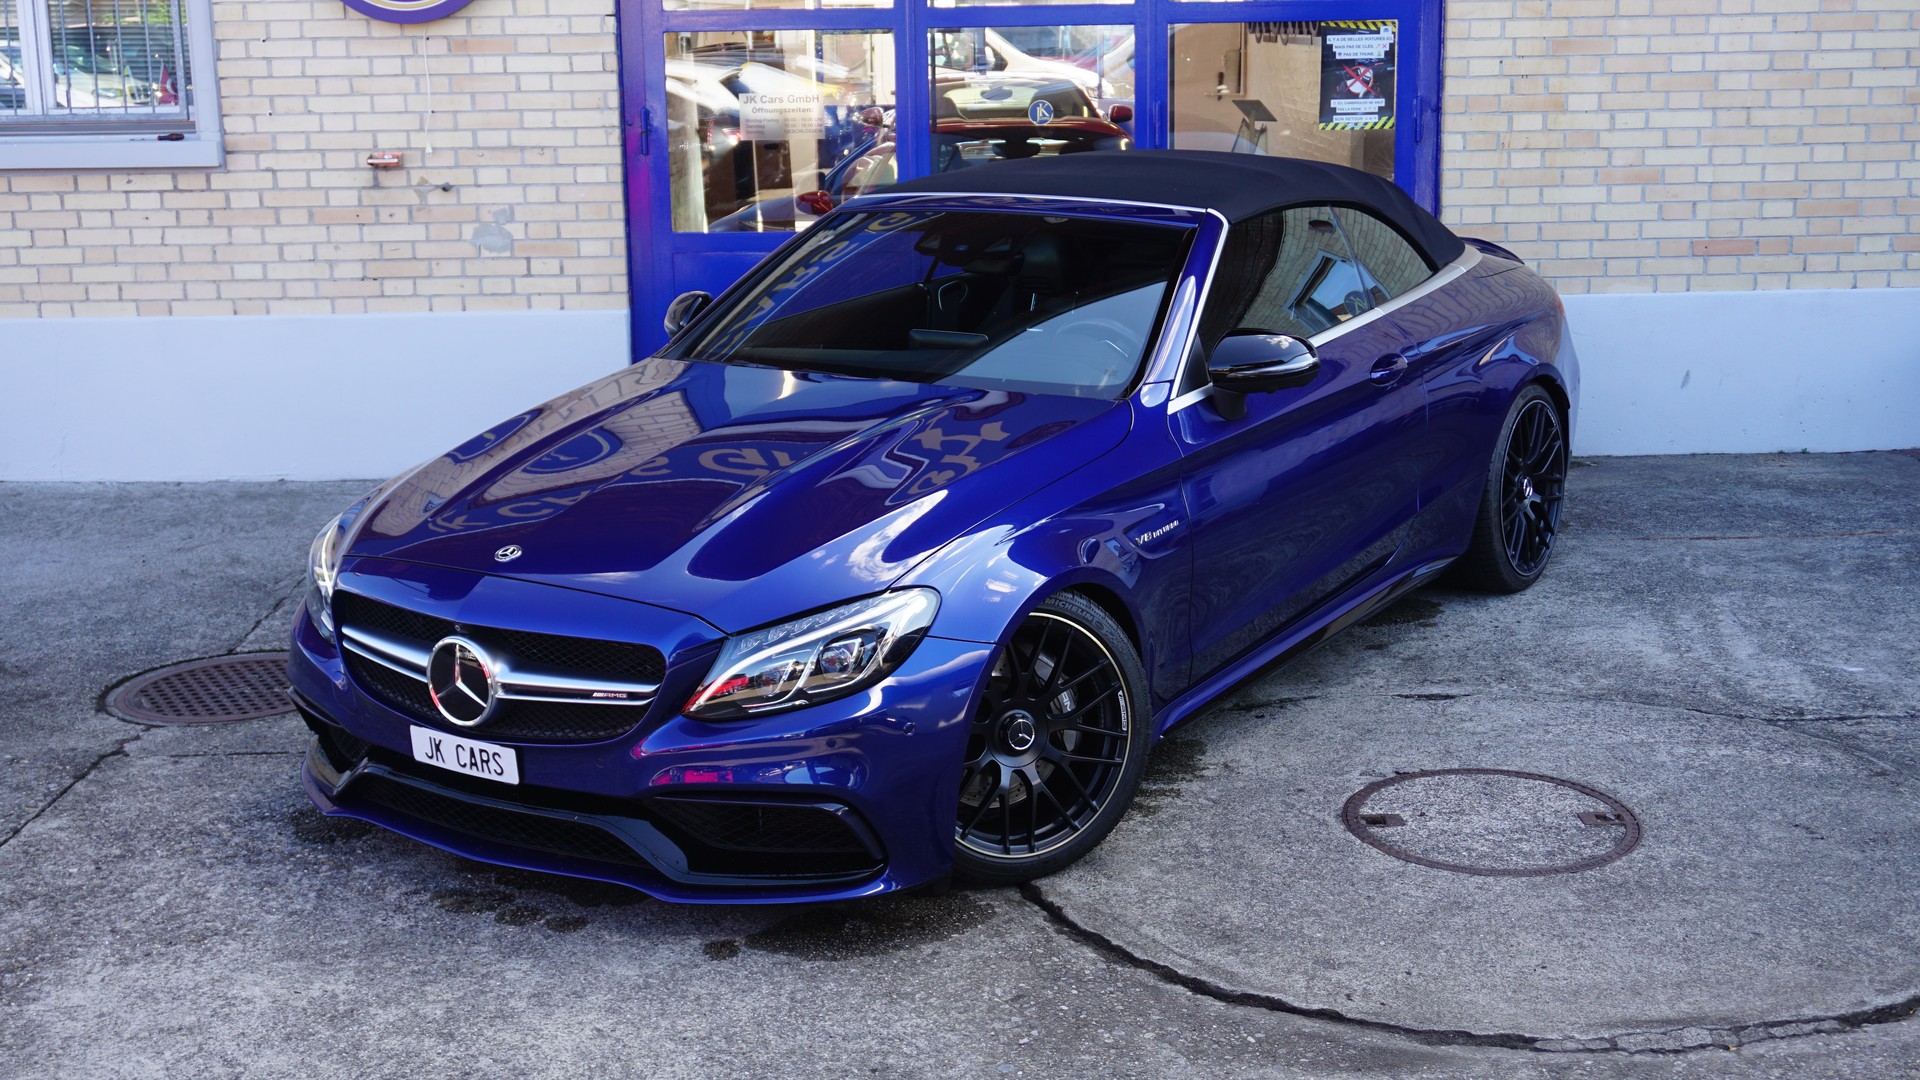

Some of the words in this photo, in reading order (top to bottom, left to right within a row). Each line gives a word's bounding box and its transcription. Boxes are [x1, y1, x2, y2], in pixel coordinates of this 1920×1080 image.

[743, 95, 757, 104] JK
[760, 95, 784, 104] Cars
[787, 94, 819, 103] GmbH
[752, 106, 814, 114] Öffnungszeiten:
[1135, 531, 1152, 545] V8
[1045, 597, 1094, 621] MICHELIN
[425, 736, 446, 764] JK
[455, 744, 504, 776] CARS
